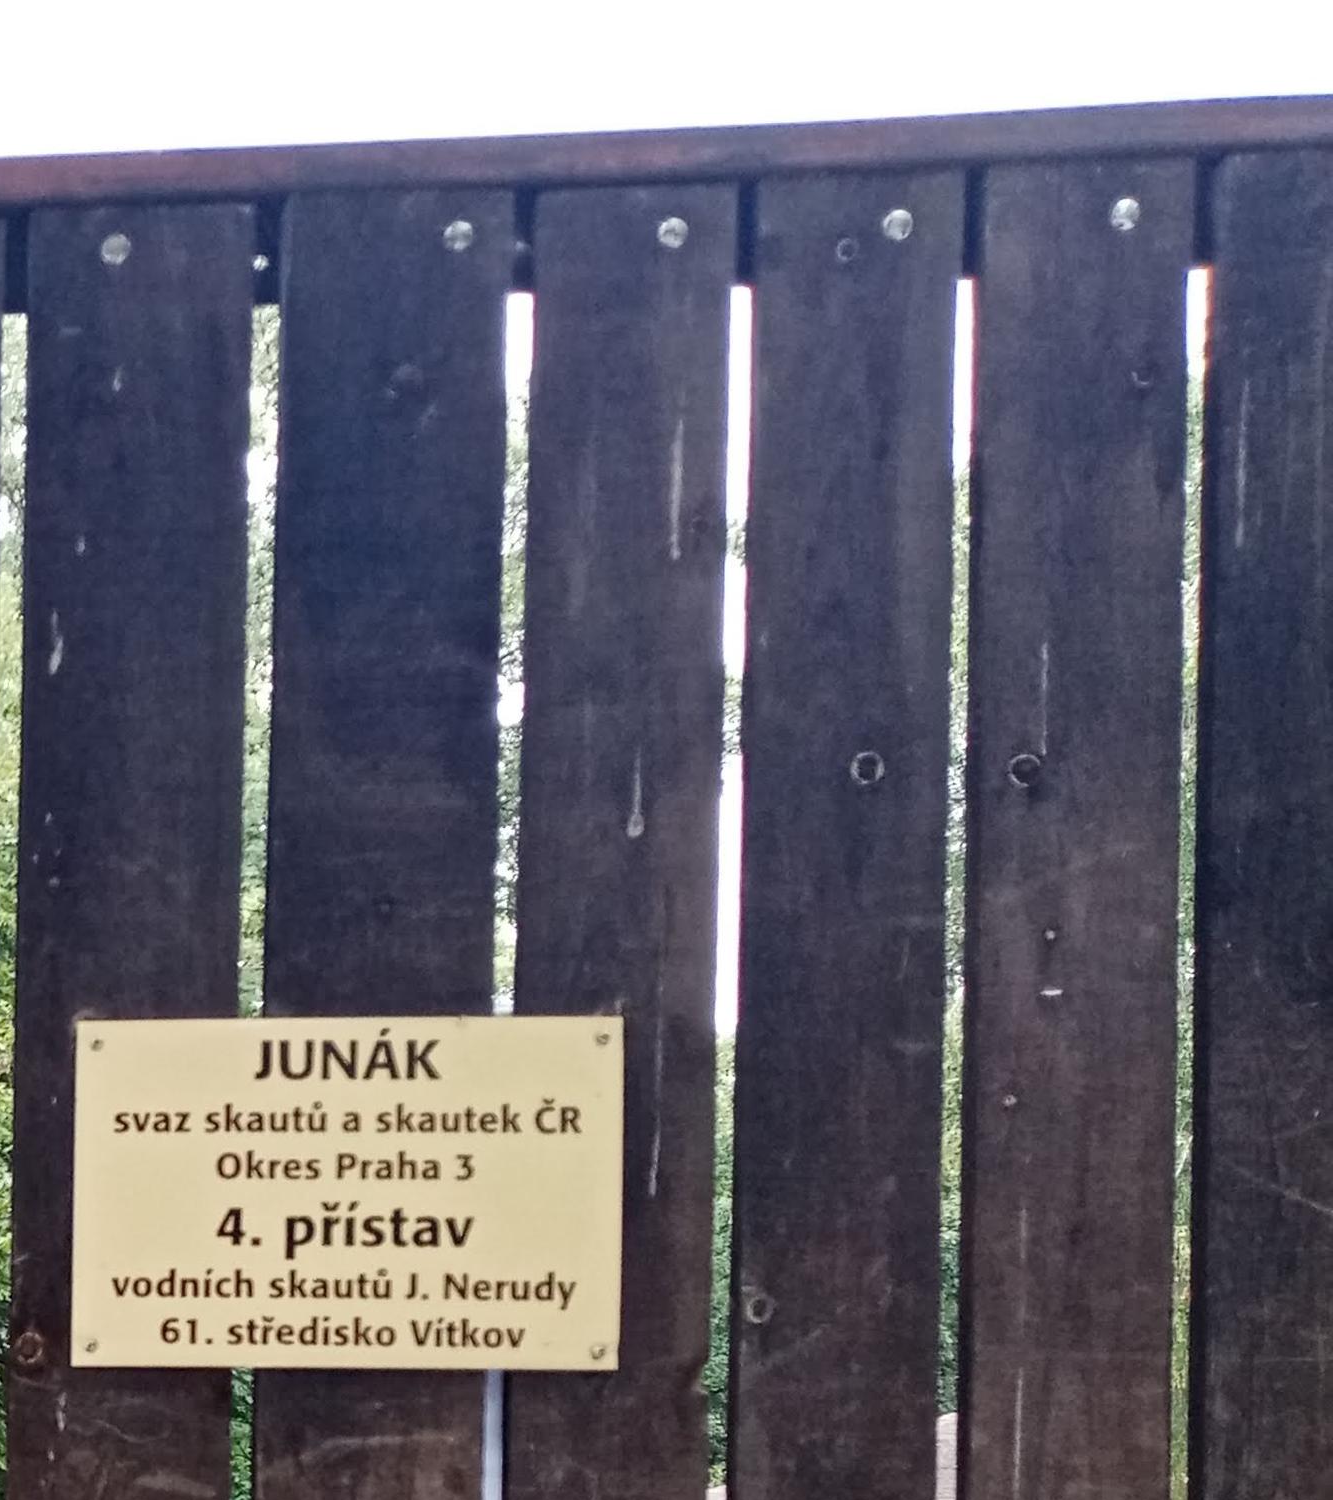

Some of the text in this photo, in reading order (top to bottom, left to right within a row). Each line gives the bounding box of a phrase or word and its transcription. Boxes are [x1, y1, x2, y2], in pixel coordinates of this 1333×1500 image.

[254, 1028, 440, 1081] JUNÁK
[114, 1098, 582, 1134] svaz skautů a skautek ČR
[216, 1151, 475, 1181] Okres Praha 3
[216, 1202, 474, 1260] 4. přístav
[112, 1268, 576, 1310] vodních skautů J. Nerudy
[160, 1316, 526, 1349] 61. středisko Vítkov
